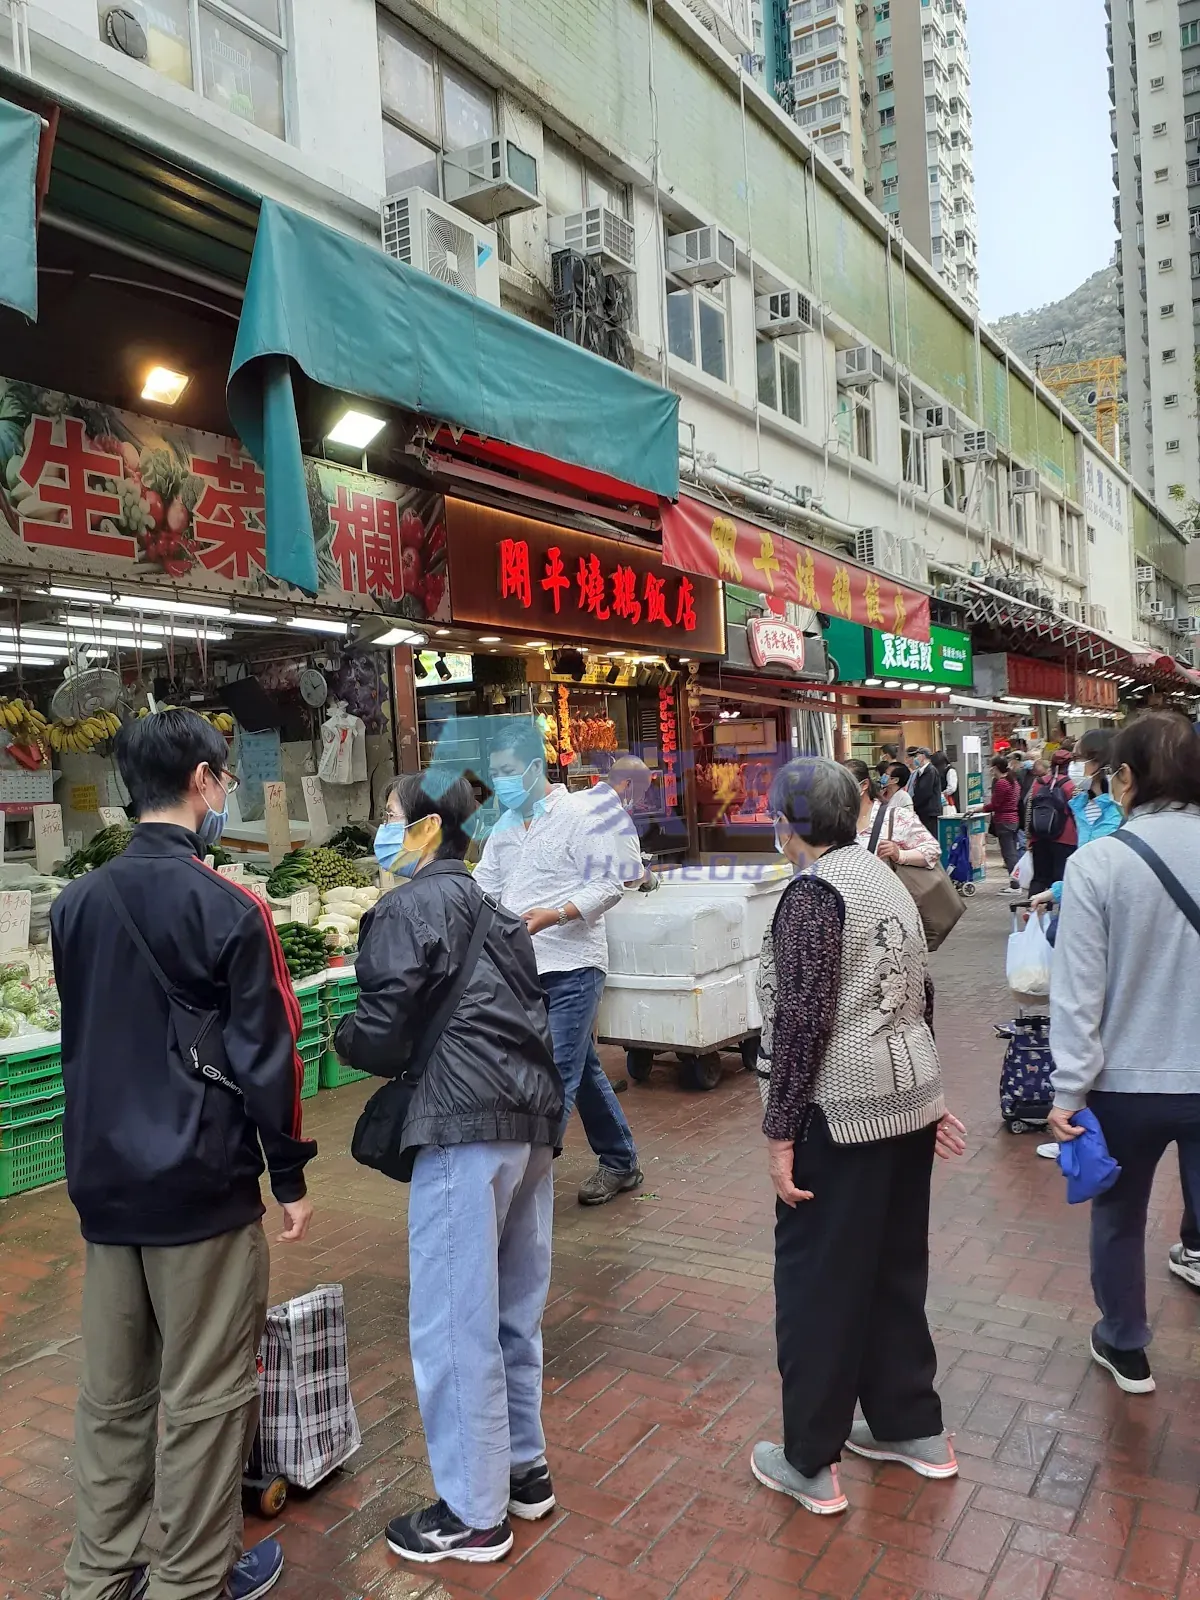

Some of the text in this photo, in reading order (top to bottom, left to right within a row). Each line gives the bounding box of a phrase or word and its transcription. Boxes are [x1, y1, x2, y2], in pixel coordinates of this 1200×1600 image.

[19, 414, 403, 601] 生菜欄
[500, 538, 697, 632] 開平燒鵝飯店
